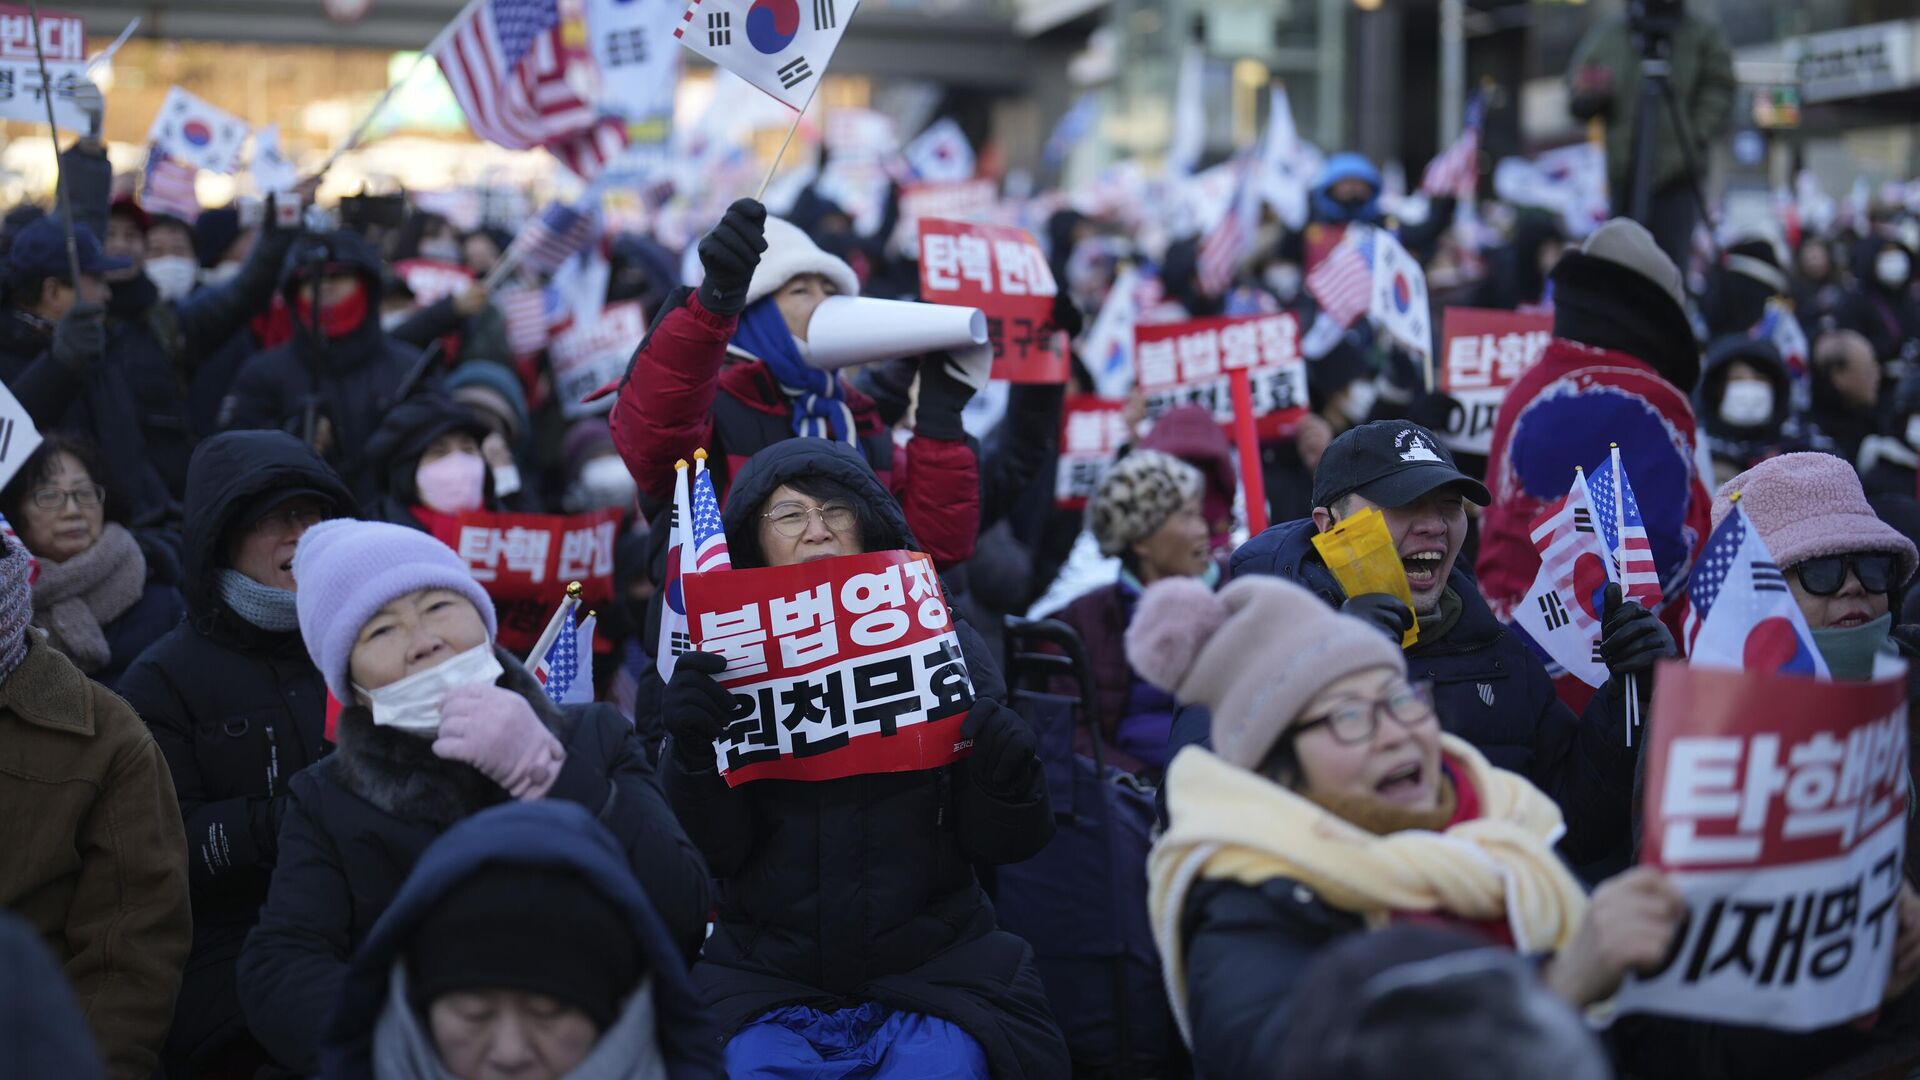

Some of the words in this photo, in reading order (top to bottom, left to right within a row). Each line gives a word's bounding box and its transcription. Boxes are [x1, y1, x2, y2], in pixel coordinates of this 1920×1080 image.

[923, 233, 993, 293] 탄핵
[1139, 313, 1298, 386] 불법영장
[459, 526, 551, 583] 탄핵
[700, 558, 948, 682] 불법영장
[714, 639, 973, 772] 원천무효
